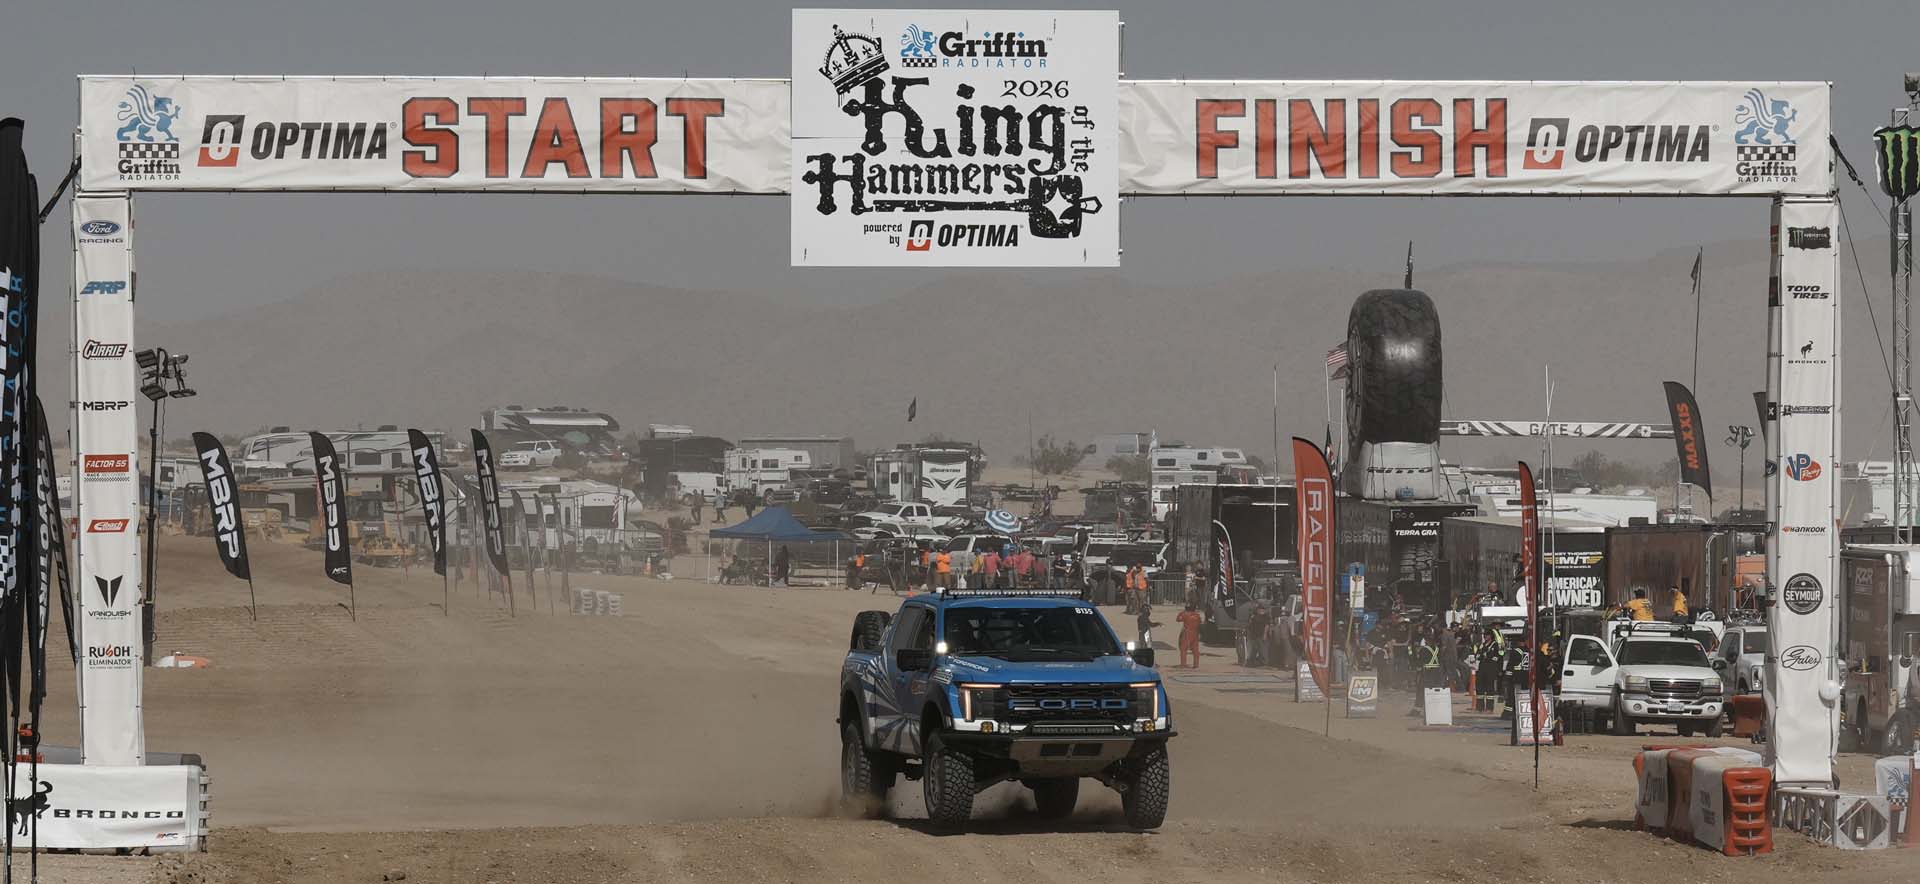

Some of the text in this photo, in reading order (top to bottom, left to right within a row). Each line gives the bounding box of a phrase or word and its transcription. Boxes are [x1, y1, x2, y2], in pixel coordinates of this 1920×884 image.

[939, 31, 1047, 58] Griffin
[943, 58, 1047, 68] RADIATOR
[1000, 80, 1069, 98] 2026
[842, 76, 1066, 175] King
[250, 121, 387, 160] OPTIMA
[402, 97, 725, 179] START
[1070, 105, 1095, 173] of the
[1195, 98, 1508, 179] FINISH
[1575, 124, 1710, 163] OPTIMA
[118, 159, 181, 174] Griffin
[1736, 161, 1798, 176] Griffin
[802, 152, 1026, 215] Hammers
[88, 222, 113, 234] Ford
[863, 223, 902, 235] powered
[938, 224, 1018, 247] OPTIMA
[889, 234, 901, 247] by
[80, 281, 126, 294] PRP
[84, 340, 127, 359] CURRIE
[83, 401, 129, 411] MBRP
[1530, 423, 1583, 437] GATE 4
[1676, 402, 1700, 469] MAXXIS
[86, 460, 115, 468] FACTOR
[1787, 453, 1811, 482] VP
[202, 448, 240, 559] MBRP
[476, 448, 501, 555] MBRP
[1306, 489, 1326, 660] RACELINE
[1785, 590, 1821, 601] SEYMOUR
[1782, 648, 1821, 667] Gates
[1008, 698, 1128, 710] FORD
[54, 808, 183, 818] BRONCO
